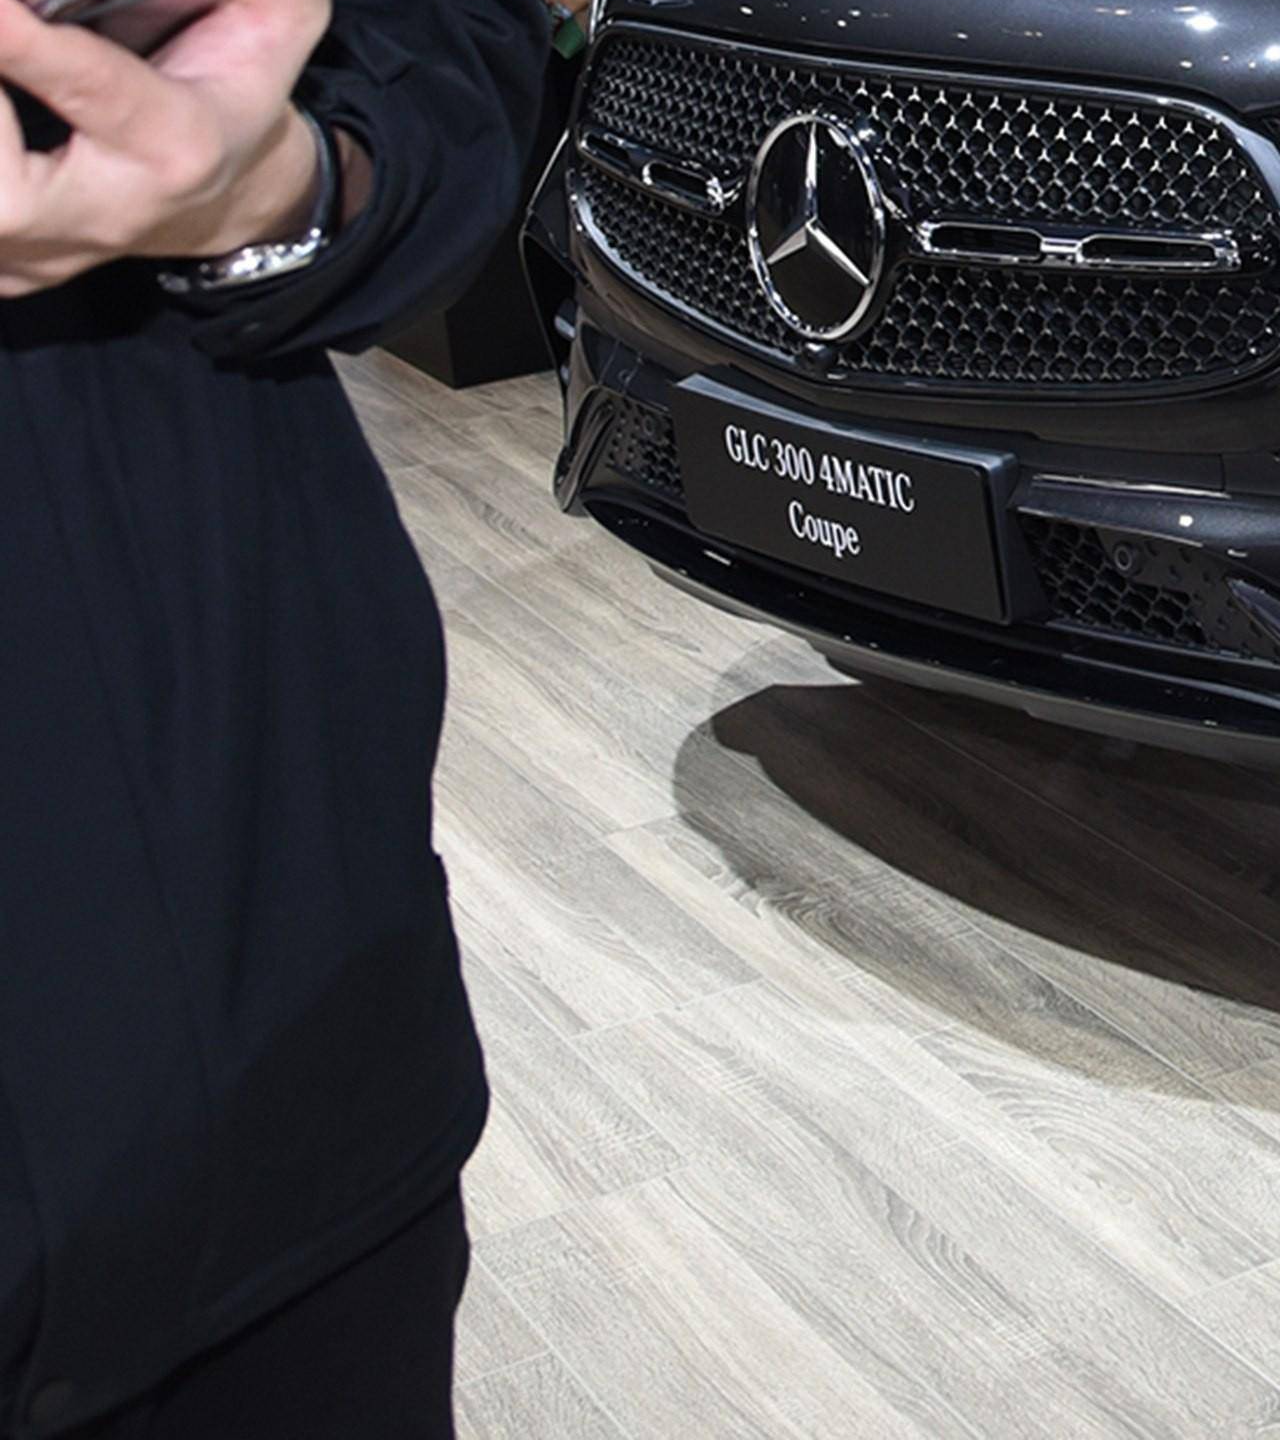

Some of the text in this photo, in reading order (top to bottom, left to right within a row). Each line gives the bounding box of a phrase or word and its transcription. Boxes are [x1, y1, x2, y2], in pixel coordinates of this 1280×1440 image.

[725, 424, 915, 513] GLC 300 4MATIC
[788, 500, 861, 559] Coupe
